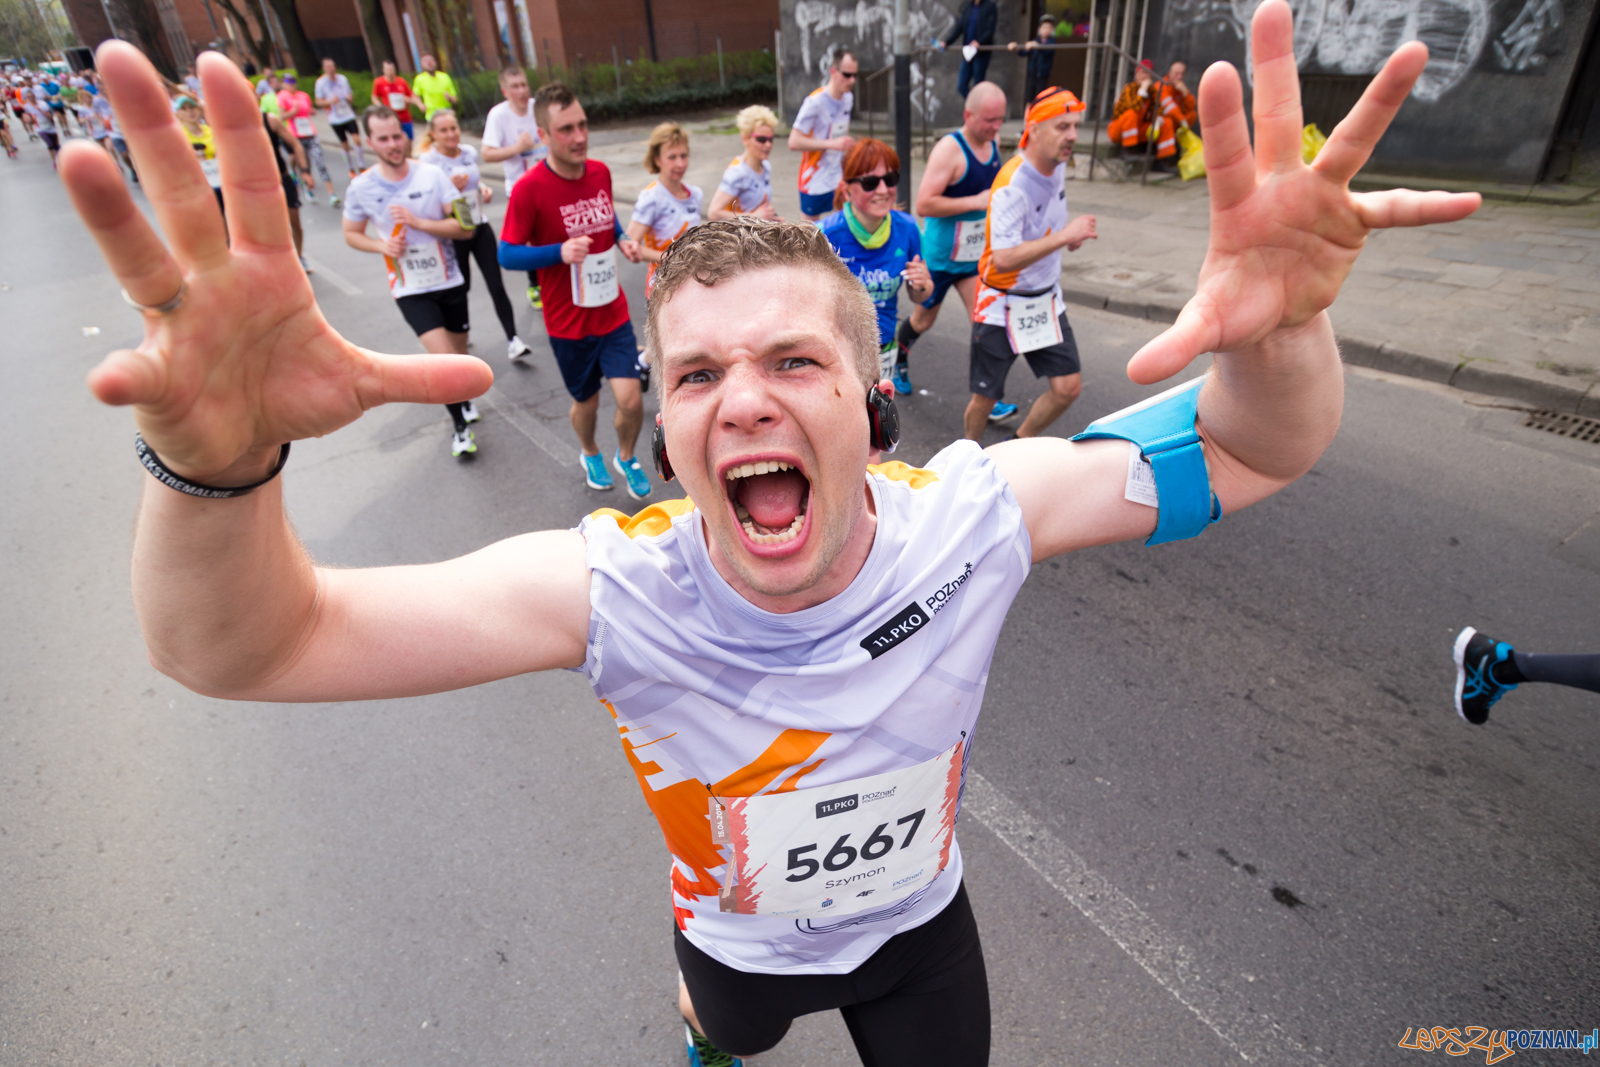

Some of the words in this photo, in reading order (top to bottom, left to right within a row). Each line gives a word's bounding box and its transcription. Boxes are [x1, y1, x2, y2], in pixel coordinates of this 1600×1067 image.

[563, 203, 614, 233] SZPIKU
[406, 256, 437, 270] 8180
[1017, 311, 1048, 330] 3298
[141, 453, 234, 498] EKSTREMALNIE
[872, 636, 893, 647] 11.
[890, 614, 922, 638] PKO
[821, 804, 833, 813] 11.
[834, 799, 855, 810] PKO
[785, 808, 926, 883] 5667
[825, 866, 886, 889] Szymon
